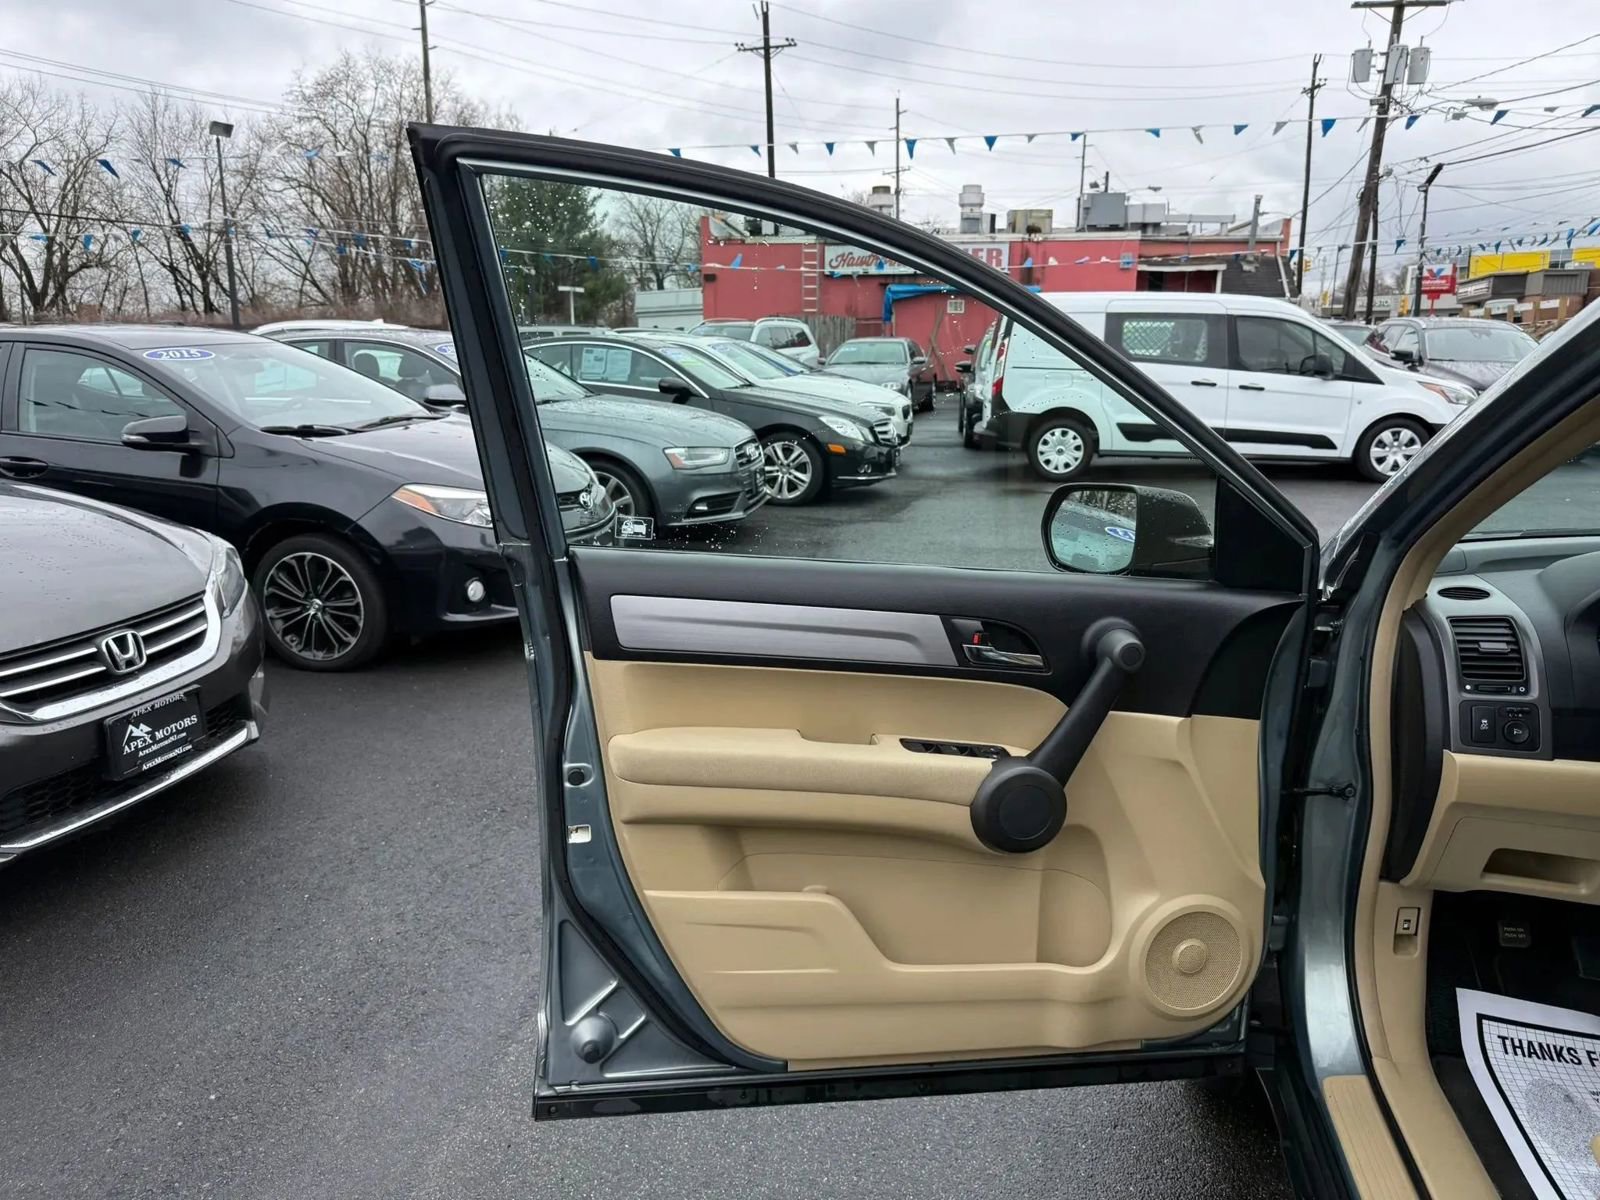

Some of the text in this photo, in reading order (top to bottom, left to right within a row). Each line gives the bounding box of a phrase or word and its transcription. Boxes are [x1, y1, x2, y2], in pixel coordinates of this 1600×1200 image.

[157, 349, 202, 359] 2015
[130, 694, 187, 719] APEX MOTORS
[123, 714, 198, 755] APEX MOTORS
[1497, 1035, 1582, 1065] THANKS
